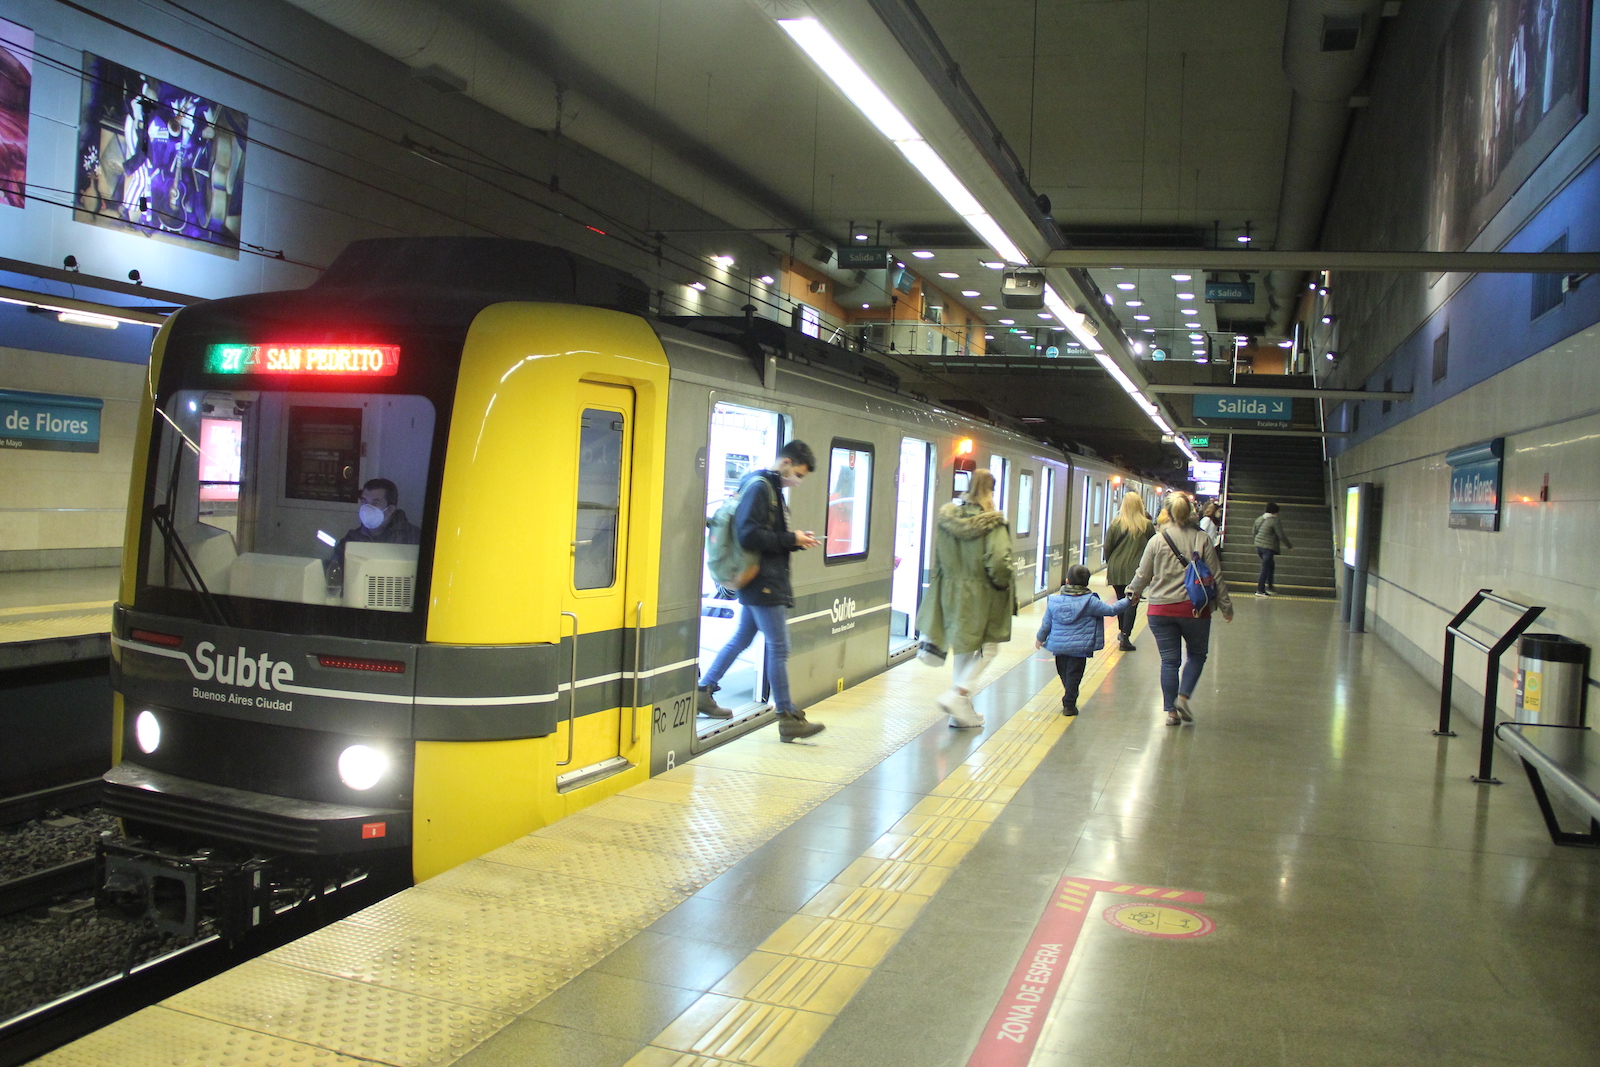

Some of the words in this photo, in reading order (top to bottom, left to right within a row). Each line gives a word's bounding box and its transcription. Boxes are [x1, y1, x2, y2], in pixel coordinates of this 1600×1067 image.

[849, 253, 874, 262] Salida
[1217, 289, 1242, 297] Salida
[222, 348, 242, 370] 27
[266, 349, 301, 370] SAN
[305, 349, 384, 371] PEDRITO
[1217, 399, 1267, 414] Salida
[5, 410, 30, 430] de
[36, 412, 89, 434] Flores
[1257, 420, 1278, 428] Escalera
[1278, 421, 1288, 429] Fija
[5, 439, 23, 448] Mayo
[1189, 437, 1209, 445] SALIDA
[1464, 474, 1473, 502] de
[1472, 473, 1494, 502] Flores
[831, 596, 856, 624] Subte
[195, 641, 294, 691] Subte
[192, 687, 226, 702] Buenos
[228, 693, 254, 707] Aires
[255, 697, 293, 712] Ciudad
[653, 707, 667, 736] Rc
[673, 696, 692, 729] 227
[1024, 943, 1063, 984] ESPERA
[1015, 984, 1045, 1003] DE
[996, 1005, 1038, 1043] ZONA
